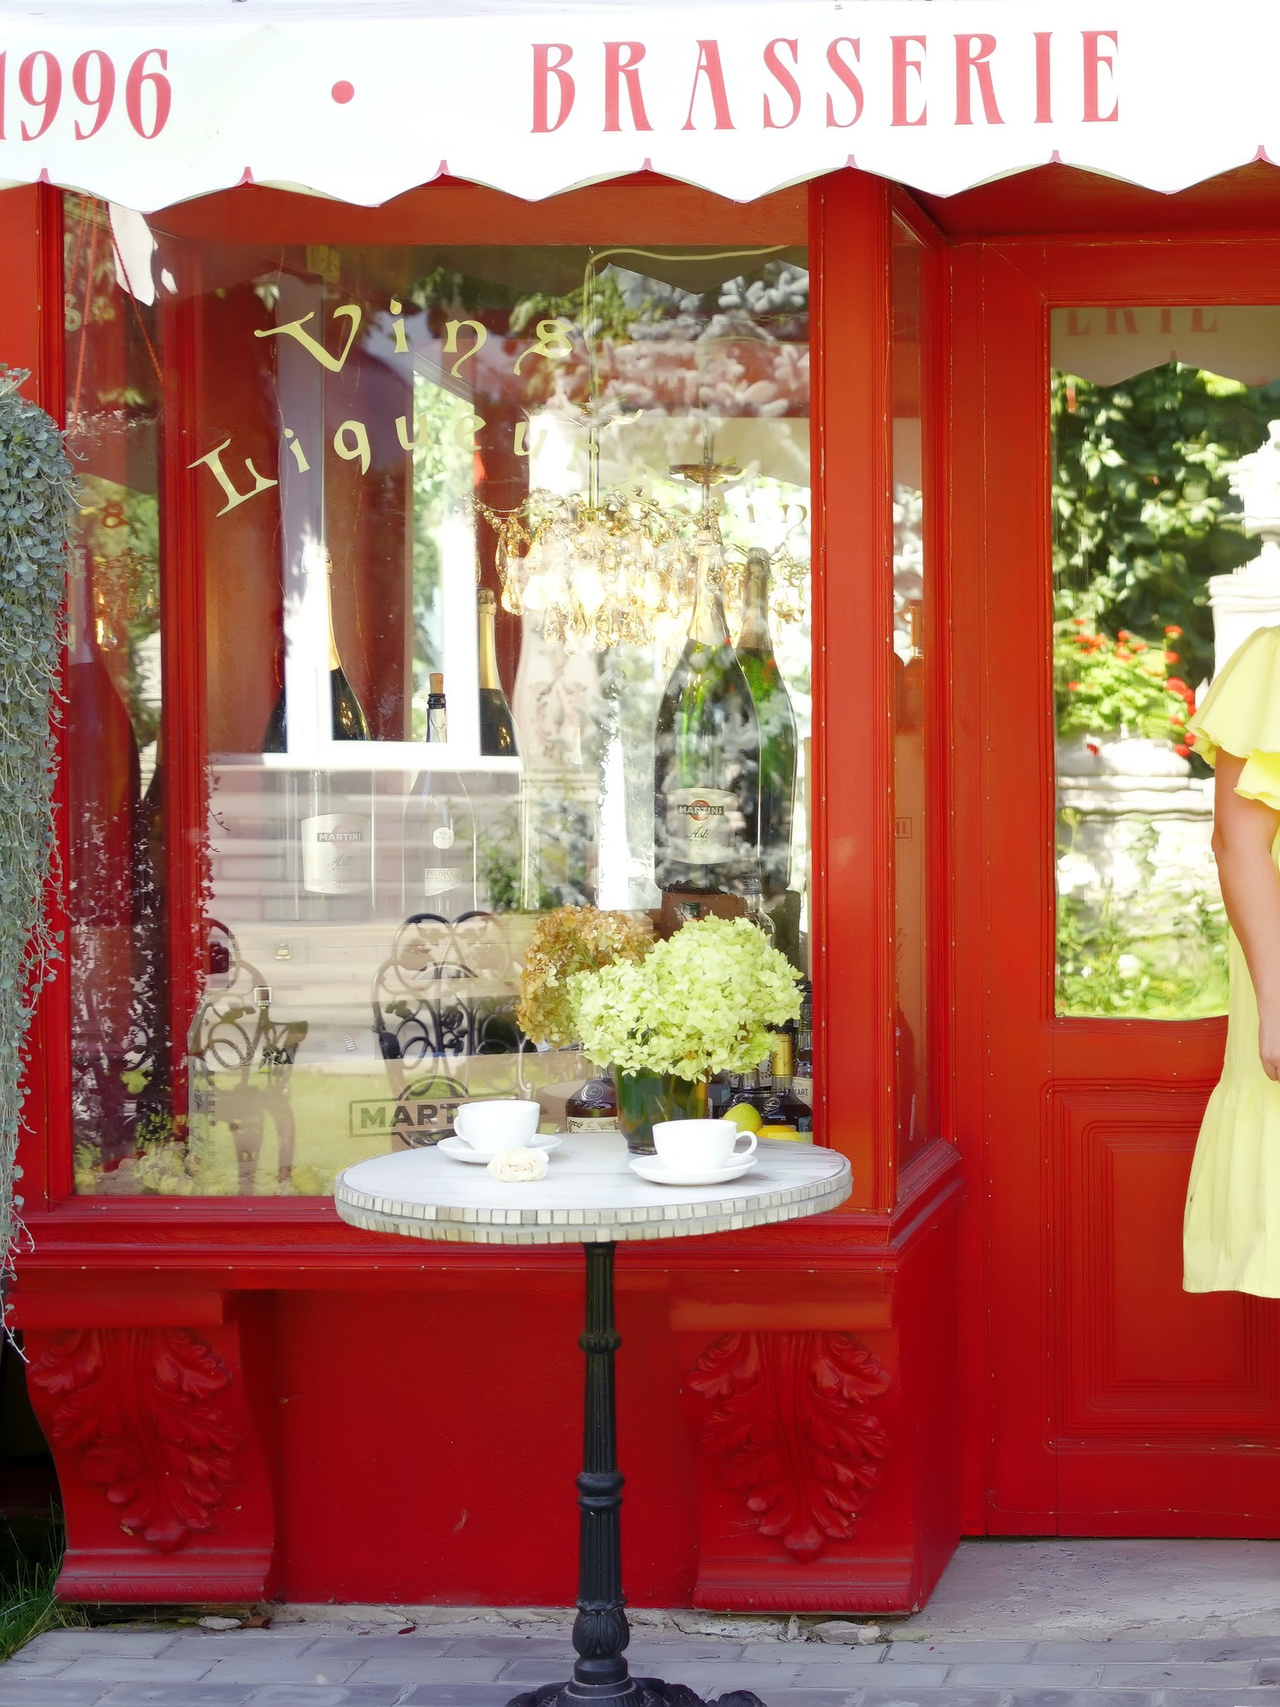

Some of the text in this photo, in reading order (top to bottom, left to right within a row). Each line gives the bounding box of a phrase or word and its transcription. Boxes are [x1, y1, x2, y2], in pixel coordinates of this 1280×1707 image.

[531, 29, 1119, 134] BRASSERIE
[254, 299, 573, 378] Vins
[679, 805, 723, 815] MARTINI
[319, 832, 361, 841] MARTINI
[426, 868, 461, 877] PROSECC
[360, 1103, 468, 1129] MART
